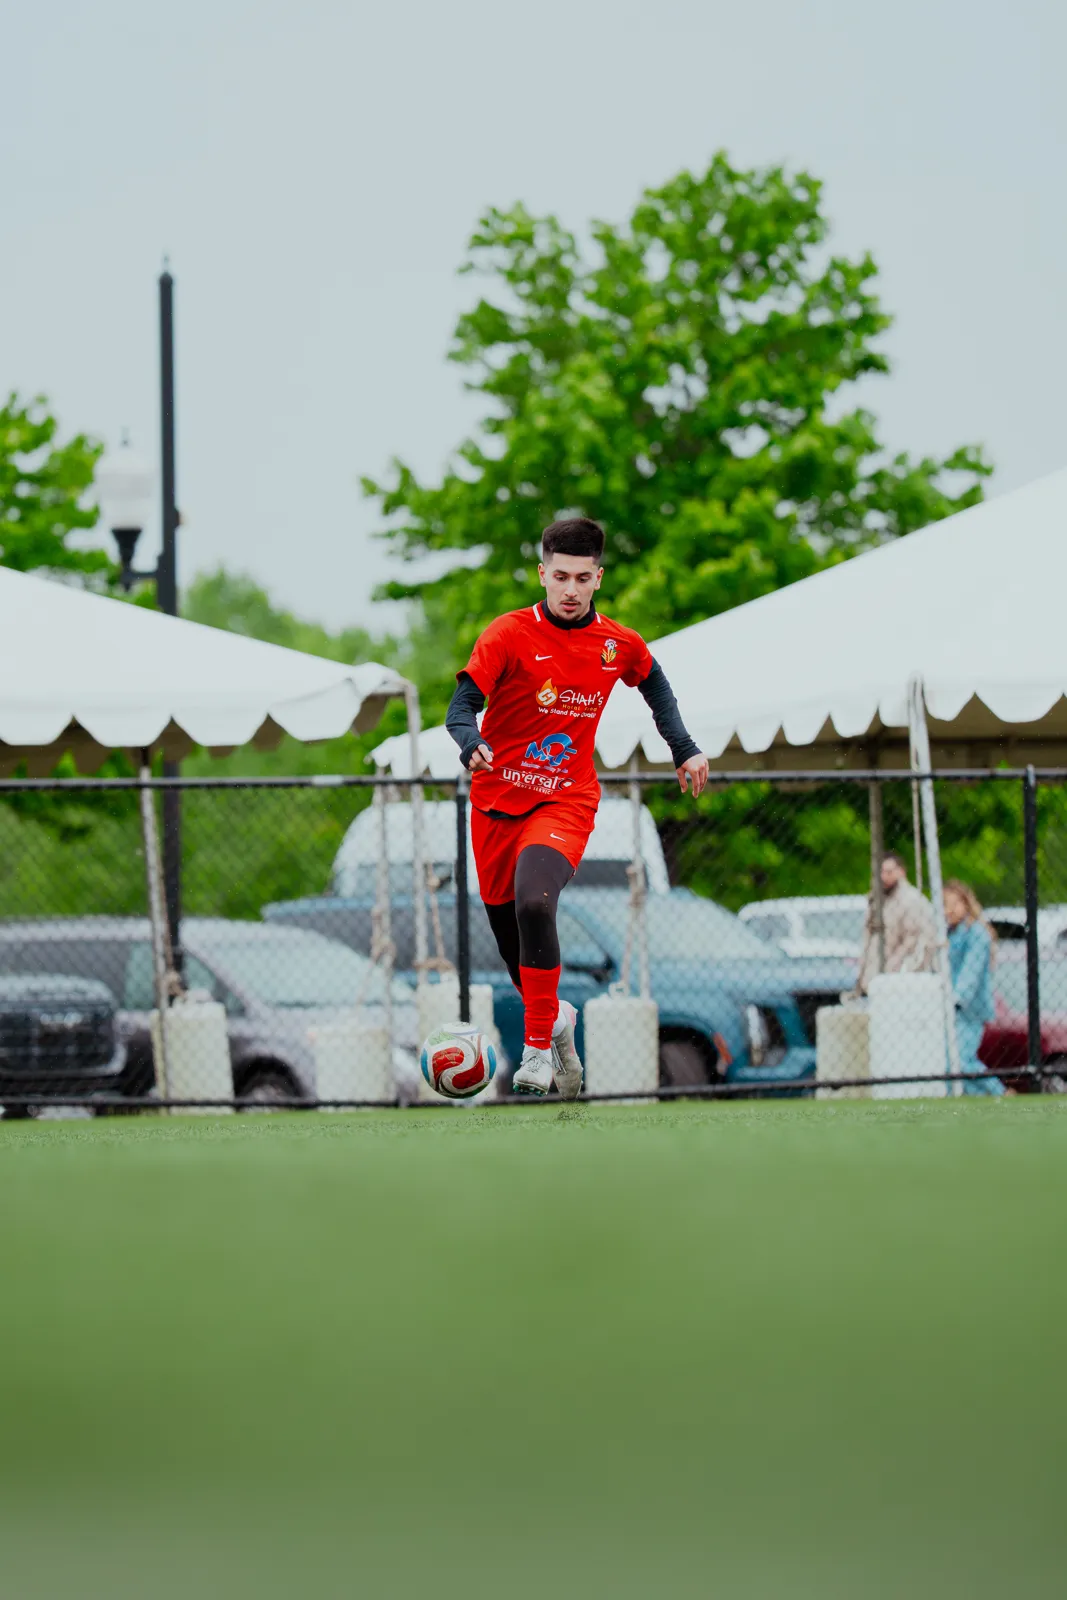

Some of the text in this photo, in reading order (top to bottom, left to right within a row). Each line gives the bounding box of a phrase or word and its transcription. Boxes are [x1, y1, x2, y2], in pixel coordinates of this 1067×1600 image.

[559, 689, 604, 706] SHAH's
[550, 708, 568, 716] Stand
[569, 710, 580, 718] For
[580, 711, 597, 719] Quali
[503, 768, 559, 790] unersal
